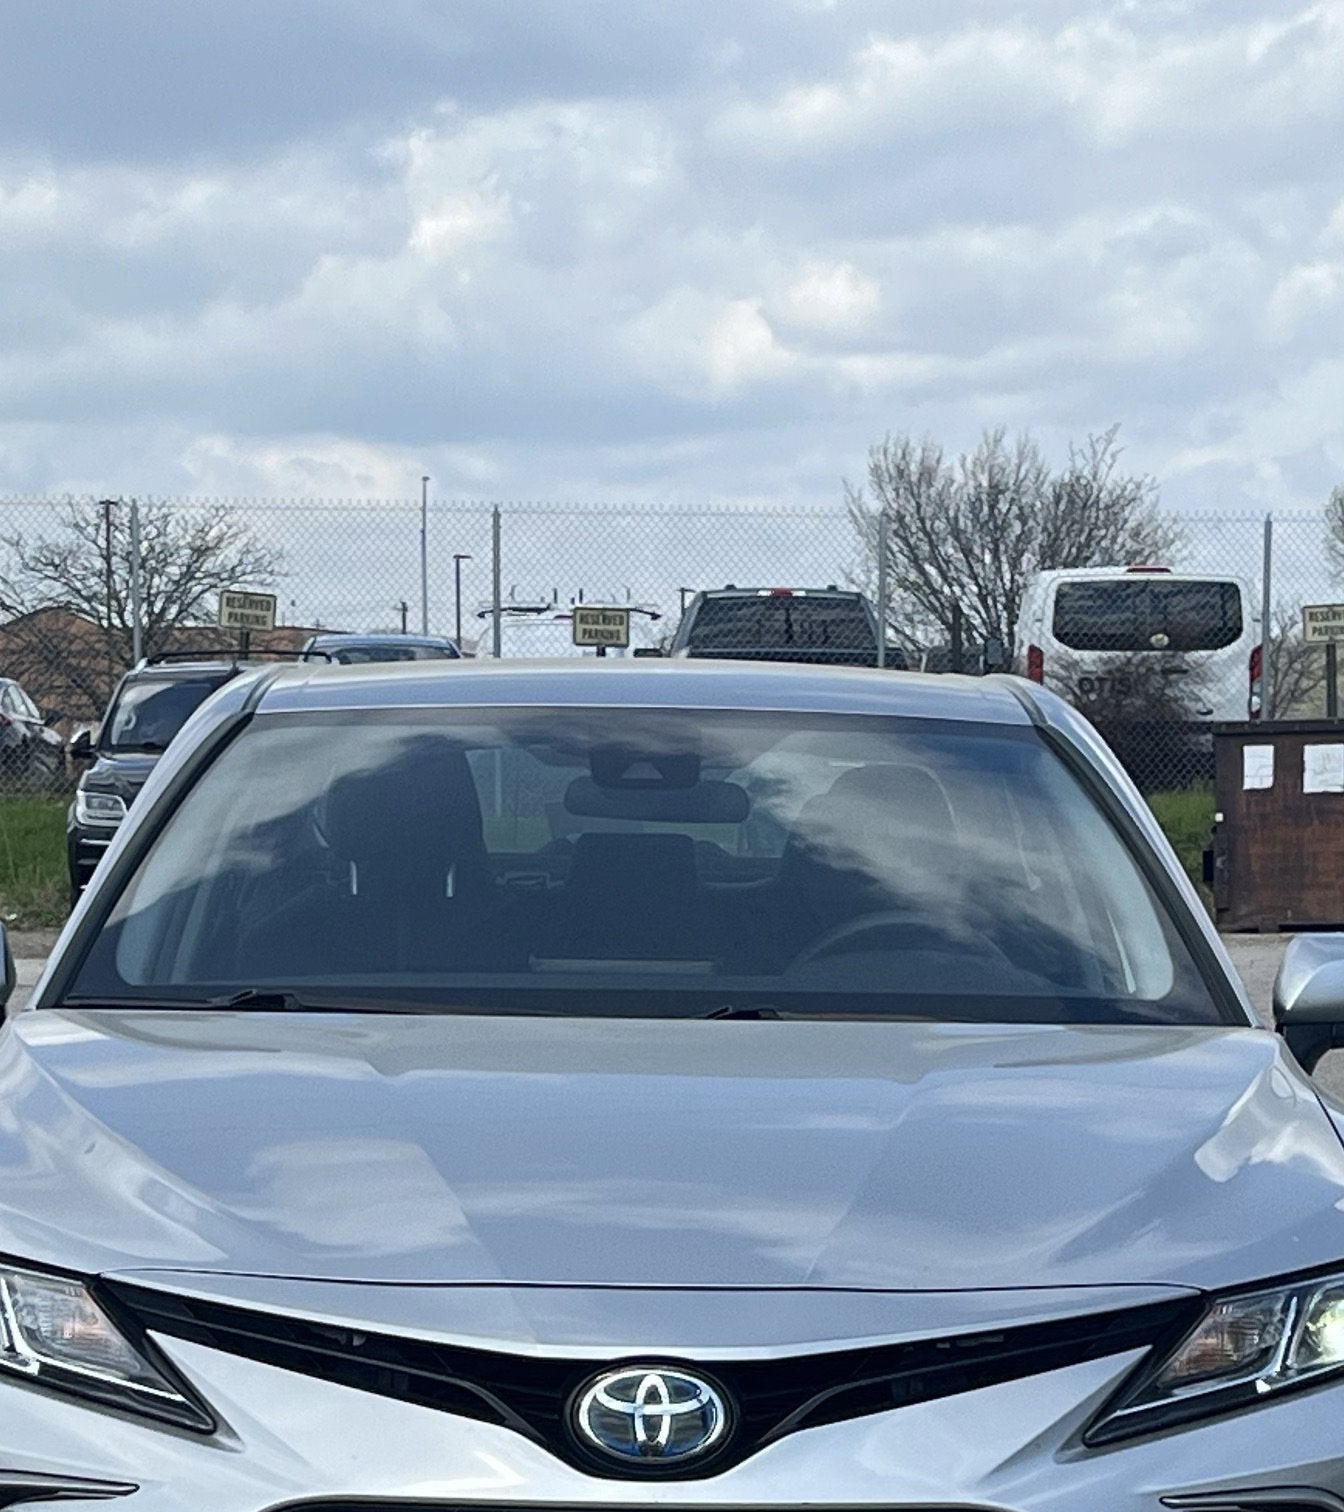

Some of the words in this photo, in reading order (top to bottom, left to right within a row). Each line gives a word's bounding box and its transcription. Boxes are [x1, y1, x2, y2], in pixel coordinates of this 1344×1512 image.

[226, 596, 271, 611] RESERVED
[227, 612, 267, 626] PARKING
[579, 612, 625, 626] RESERVED
[582, 628, 621, 641] PARKING
